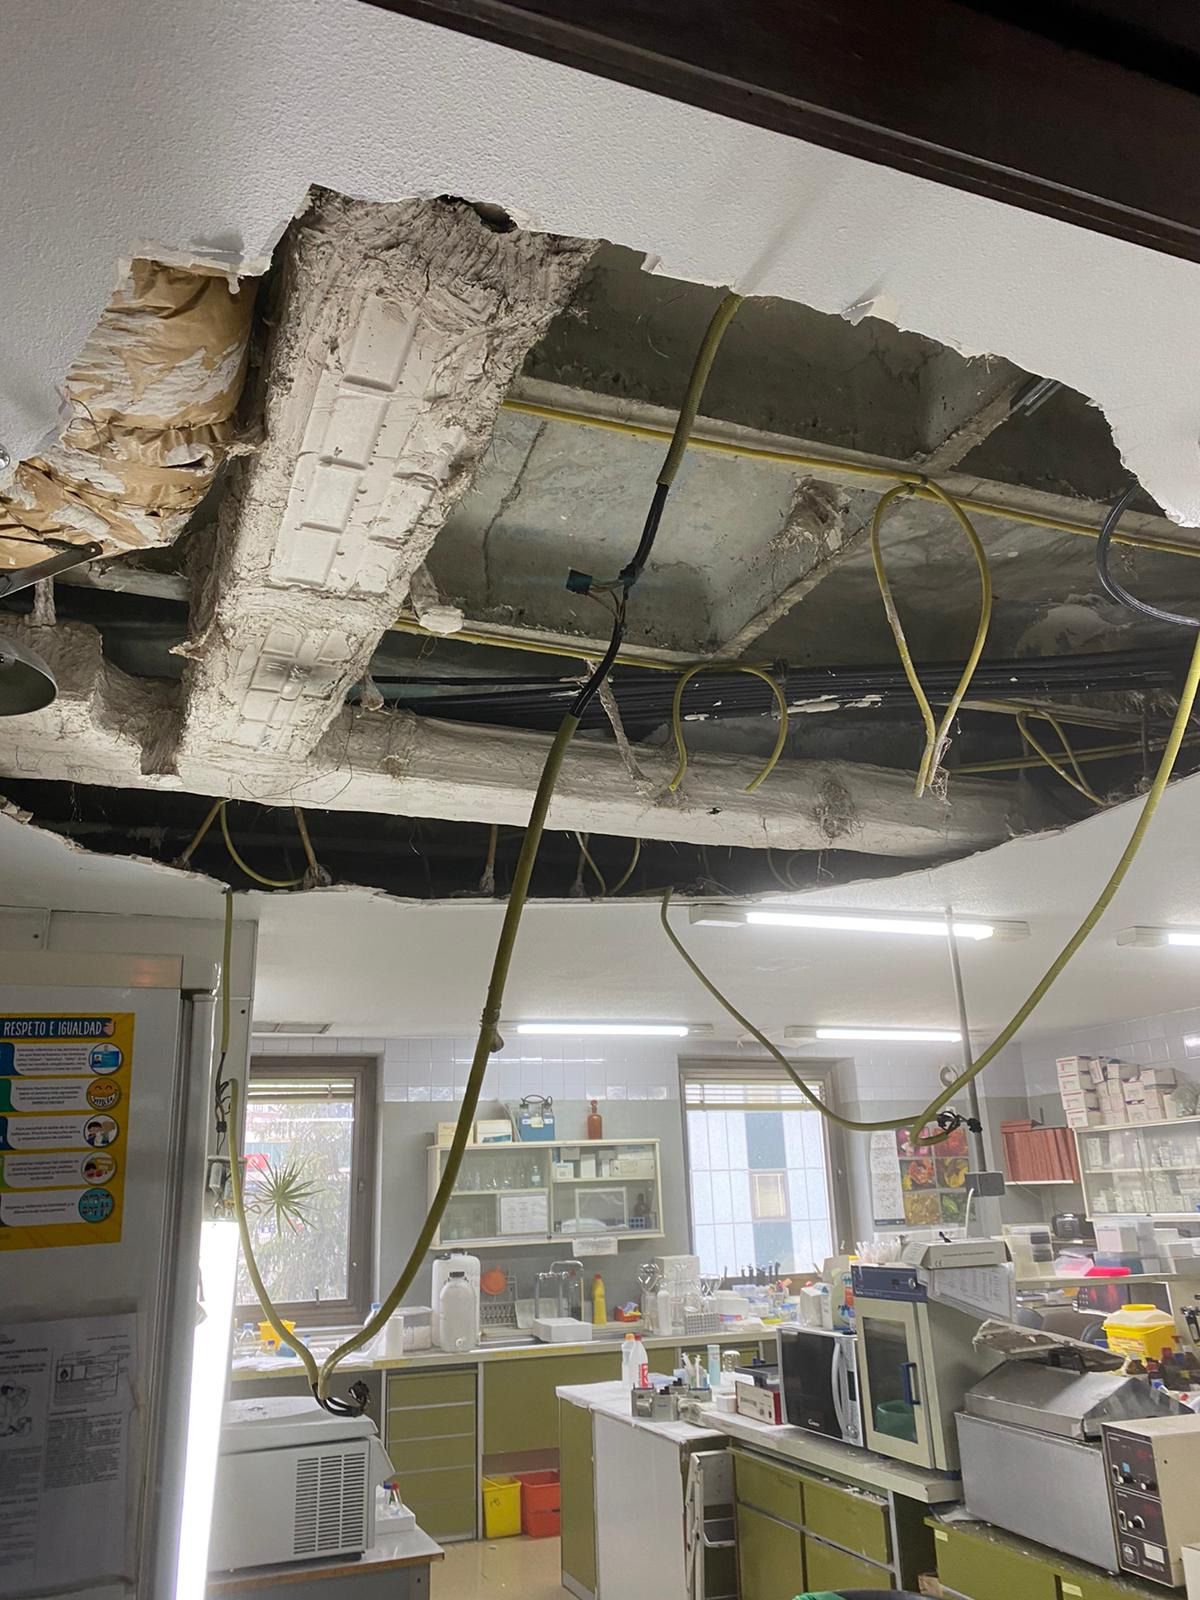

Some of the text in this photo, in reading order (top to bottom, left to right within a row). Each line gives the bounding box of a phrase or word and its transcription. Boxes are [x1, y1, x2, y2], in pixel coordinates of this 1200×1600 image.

[4, 1021, 102, 1036] RESPETO E IGUALDAD
